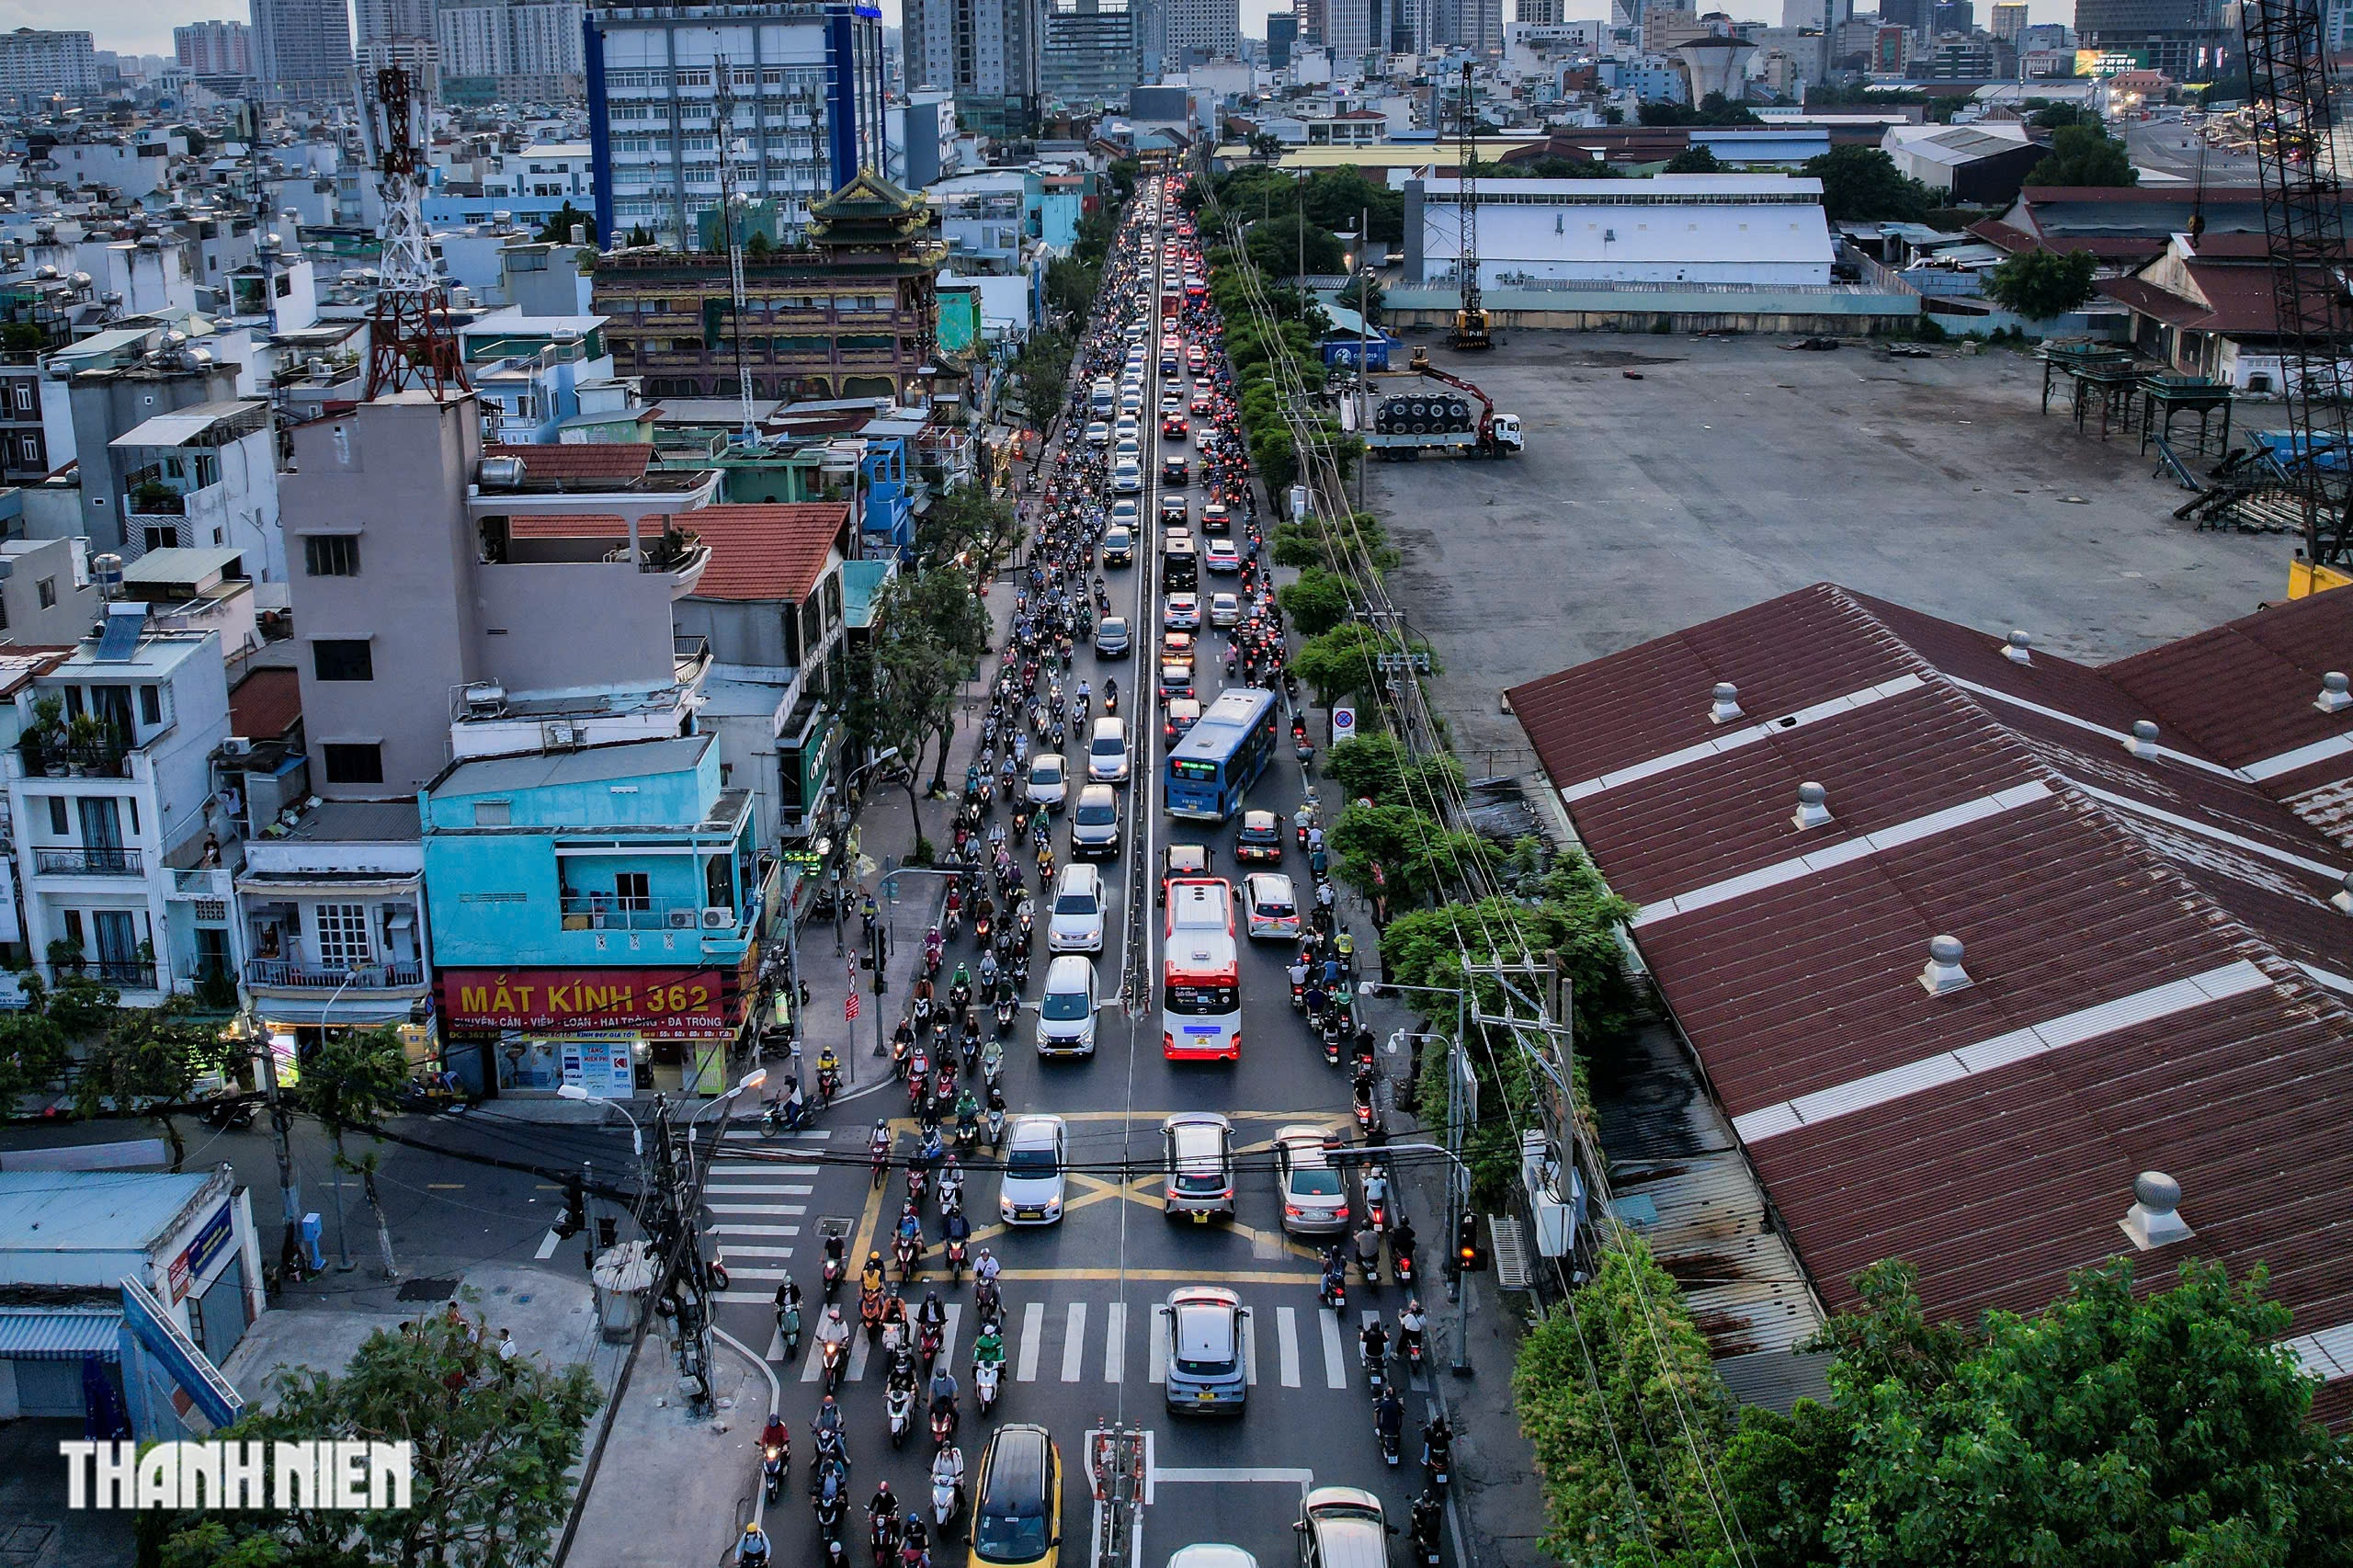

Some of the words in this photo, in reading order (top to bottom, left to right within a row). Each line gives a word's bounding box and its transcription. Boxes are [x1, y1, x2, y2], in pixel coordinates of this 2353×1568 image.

[460, 973, 535, 1013] MẮT
[547, 979, 633, 1013] KÍNH
[646, 985, 710, 1012] 362
[600, 1017, 619, 1028] HAI
[667, 1017, 683, 1027] ĐA
[685, 1015, 722, 1027] TRÒNG
